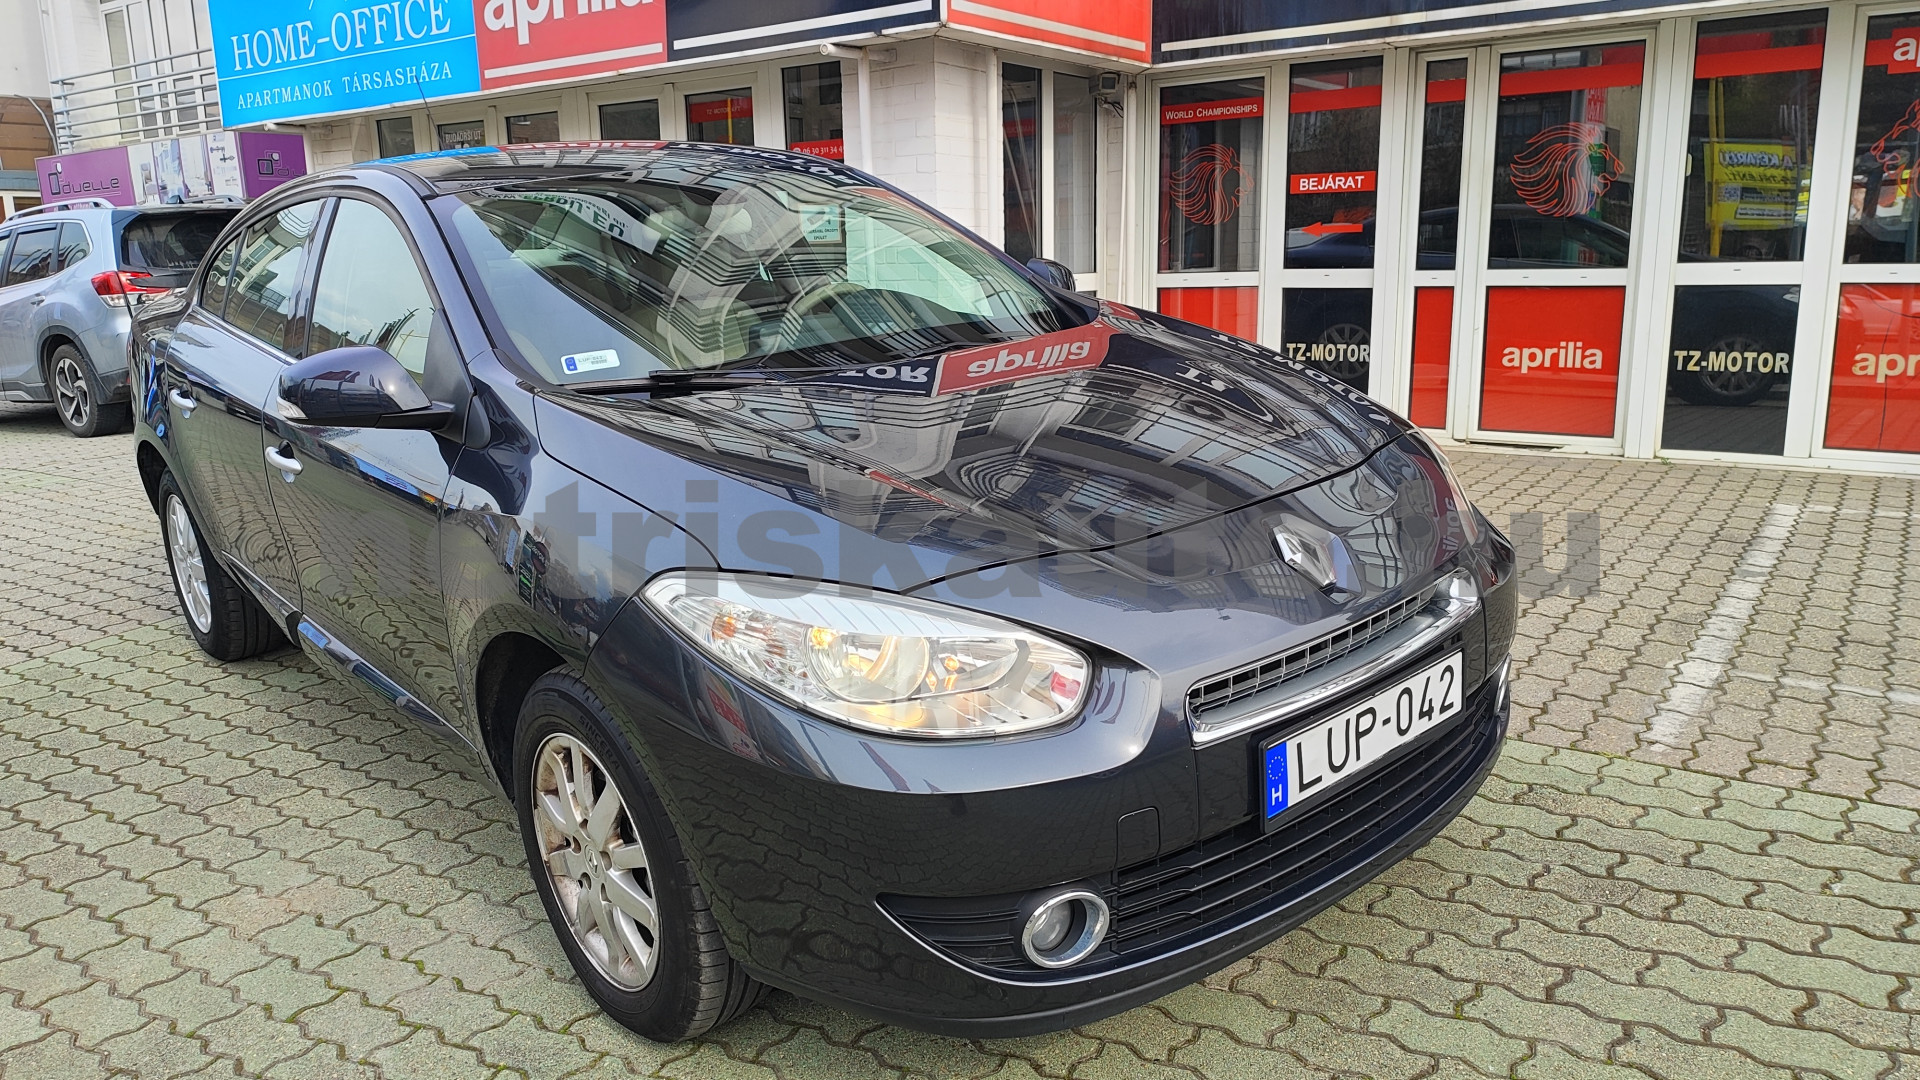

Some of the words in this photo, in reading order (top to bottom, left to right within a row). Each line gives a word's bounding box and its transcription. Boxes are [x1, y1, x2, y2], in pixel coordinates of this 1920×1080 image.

[231, 0, 451, 71] HOME-OFFICE
[237, 79, 333, 110] APARTMANOK
[342, 61, 453, 94] TÁRSASHÁZA
[1165, 109, 1194, 120] WORLD
[1196, 103, 1258, 118] CHAMPIONSHIPS
[1299, 173, 1365, 191] BEJÁRAT
[1286, 342, 1370, 363] TZ-MOTOR
[1502, 341, 1603, 374] aprilia
[1673, 350, 1790, 374] TZ-MOTOR
[1296, 664, 1455, 793] LUP-042
[1271, 784, 1283, 806] H
